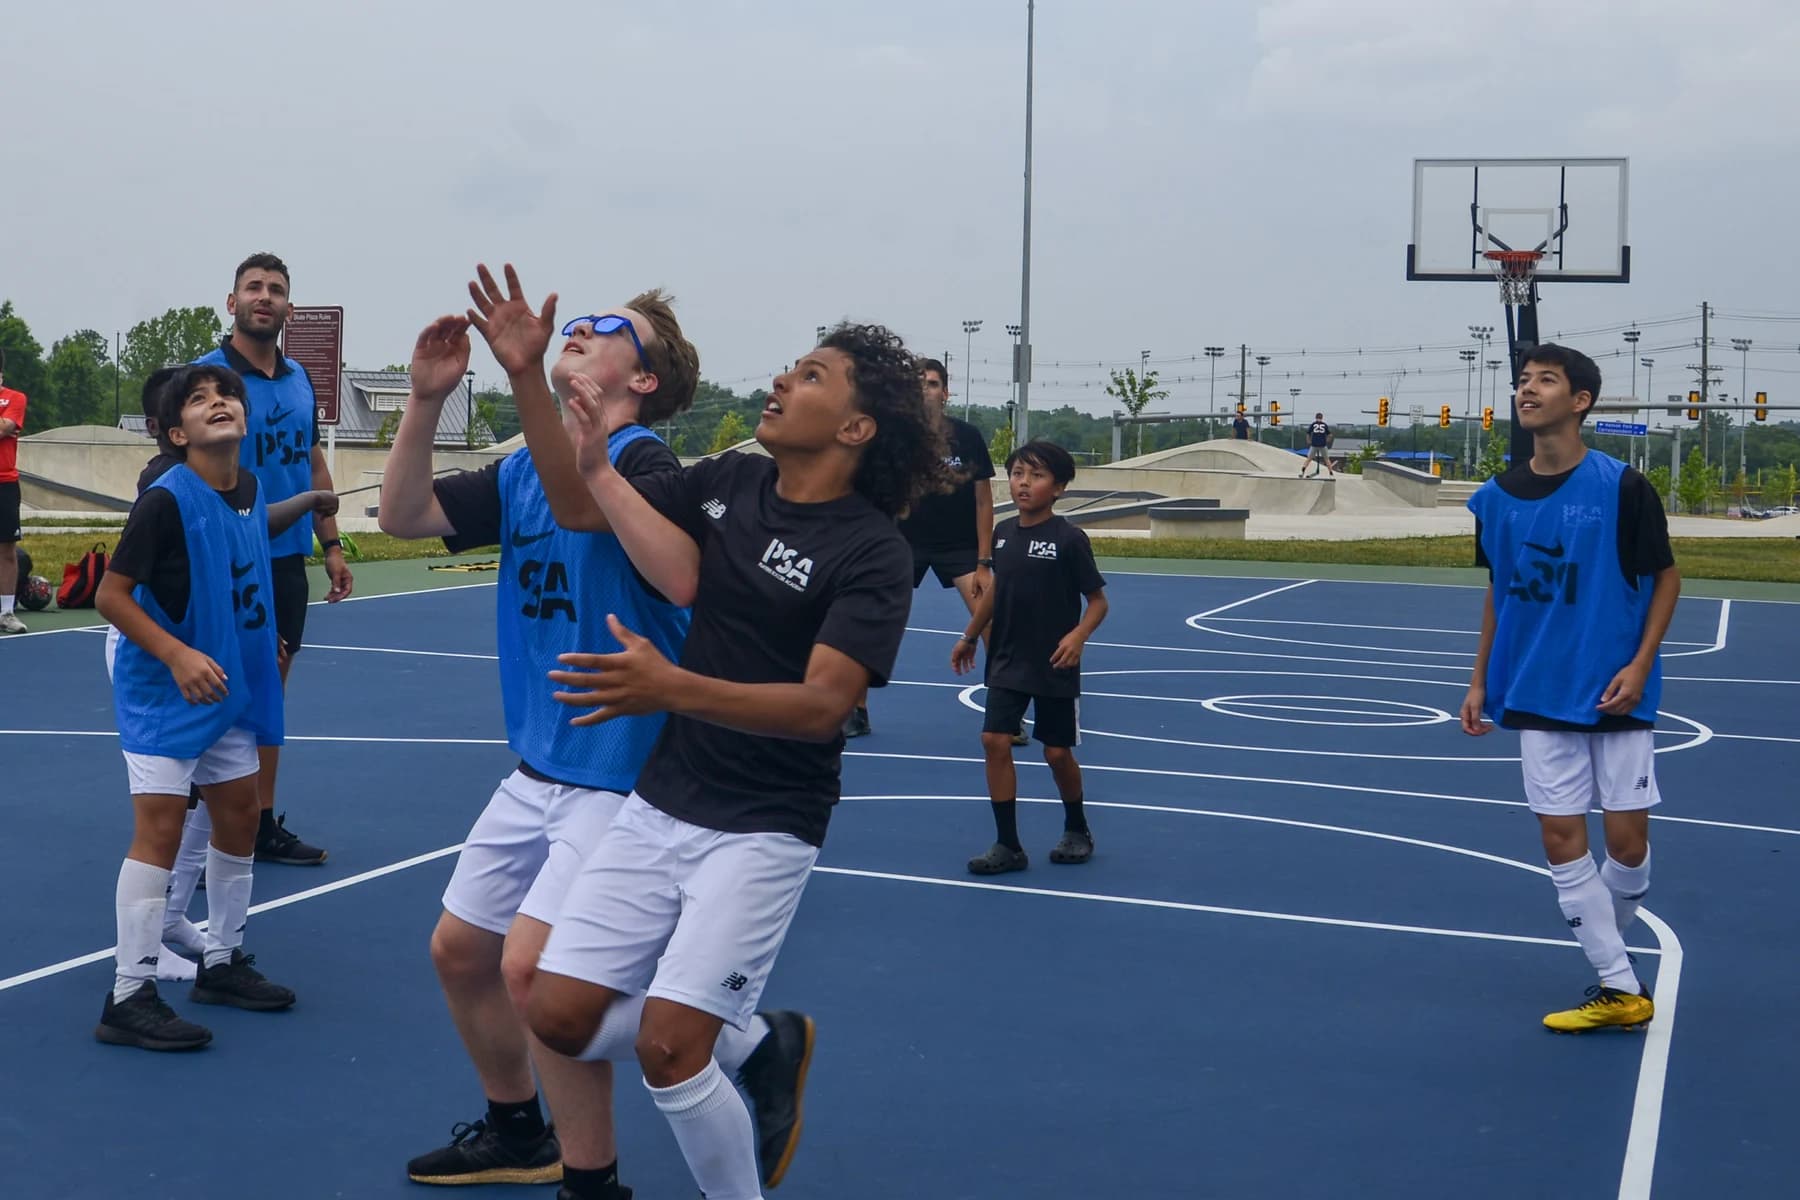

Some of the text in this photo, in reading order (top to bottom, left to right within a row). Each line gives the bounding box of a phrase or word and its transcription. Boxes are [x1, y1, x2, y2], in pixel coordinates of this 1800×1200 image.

[1313, 423, 1326, 434] 25
[256, 430, 311, 467] PSA
[1028, 540, 1057, 556] PSA
[762, 538, 813, 587] PSA
